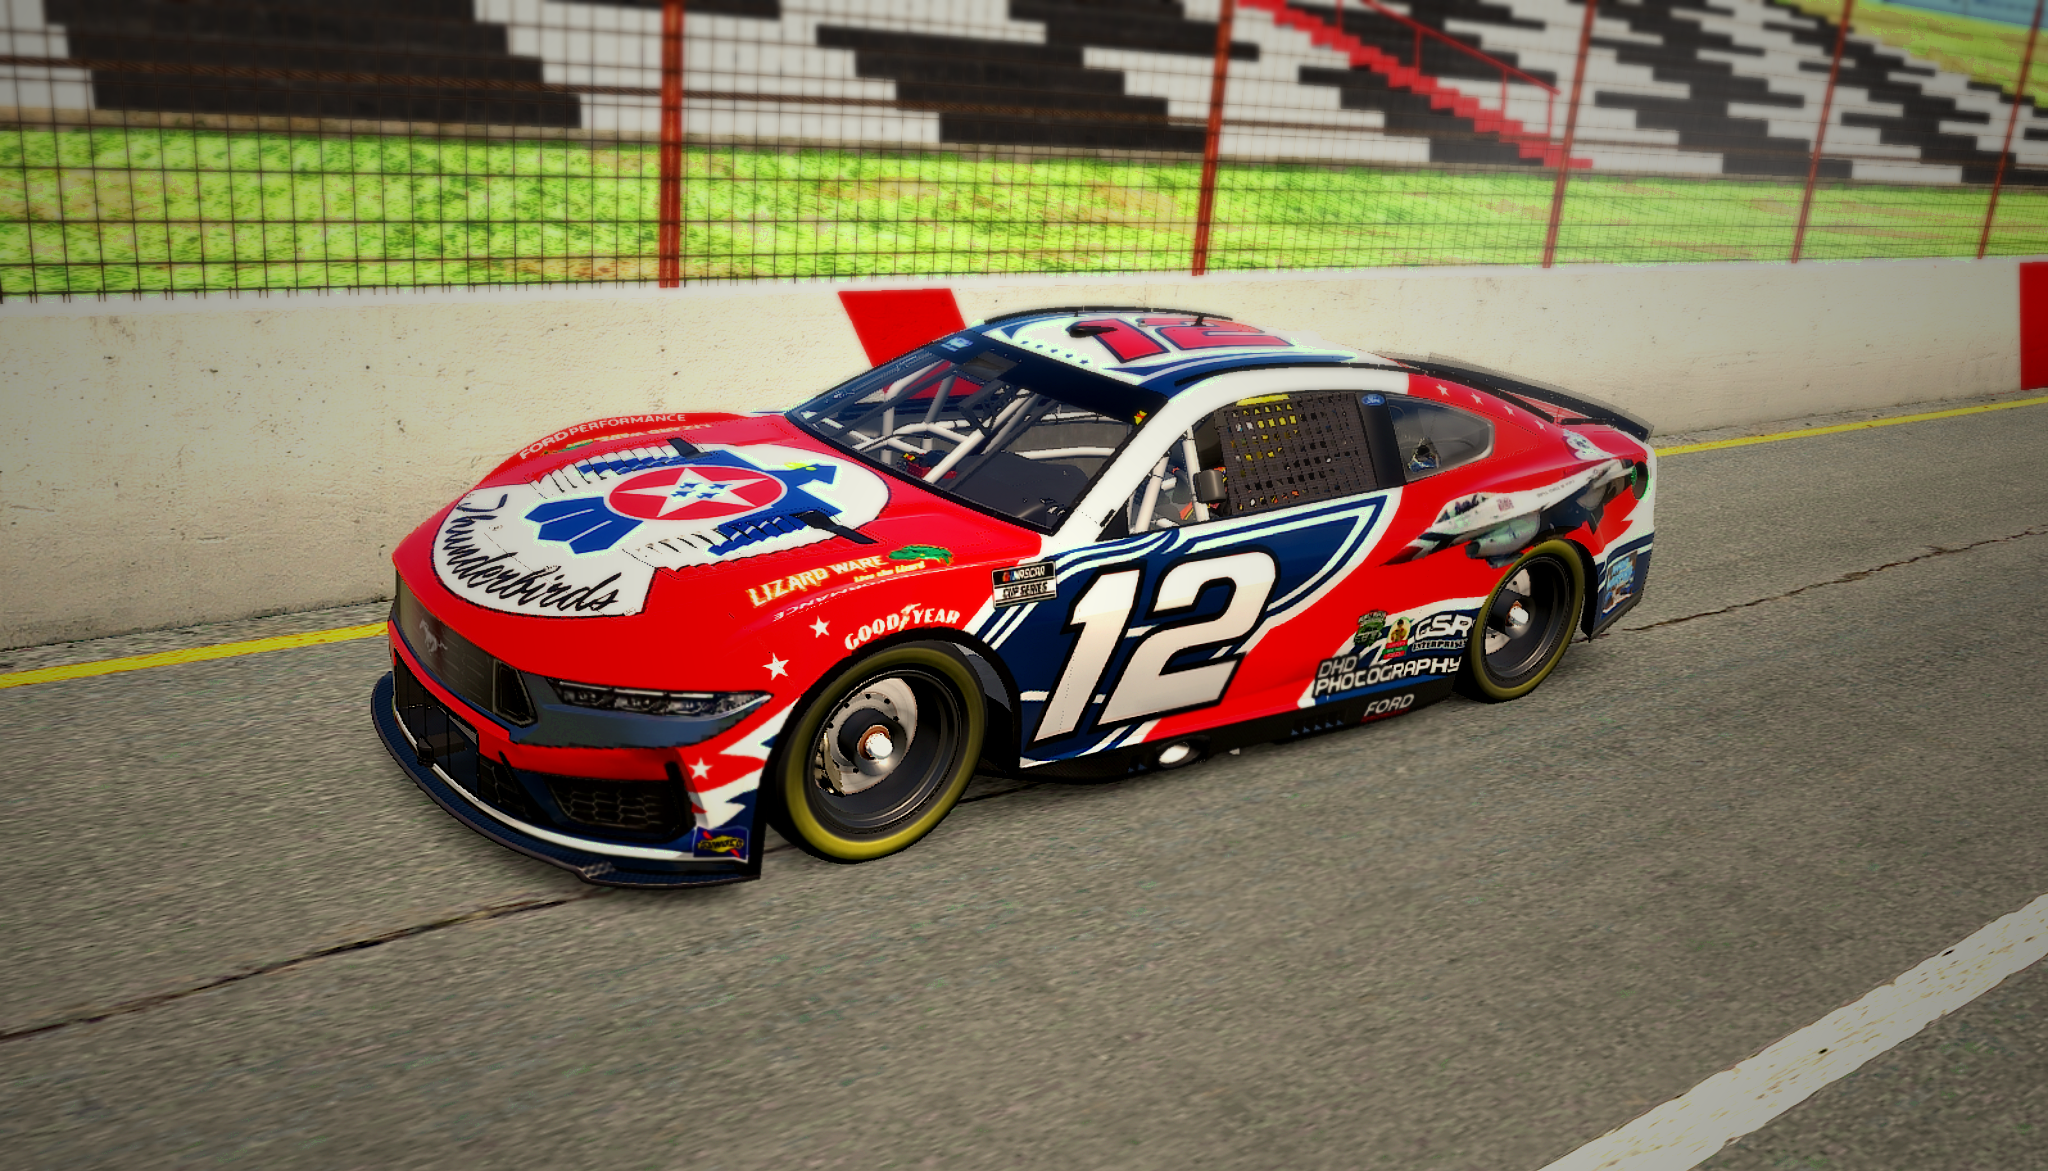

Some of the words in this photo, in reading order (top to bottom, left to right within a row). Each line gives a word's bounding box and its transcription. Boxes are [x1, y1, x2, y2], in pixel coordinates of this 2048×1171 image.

[1066, 317, 1295, 363] 12
[442, 493, 622, 611] Thunderbirds
[745, 566, 830, 608] LIZARD
[826, 555, 889, 575] WARE
[844, 603, 960, 650] GOODYEAR
[1030, 549, 1279, 745] 12
[1415, 614, 1473, 641] GSR
[1317, 655, 1359, 678] DHD
[1363, 693, 1415, 716] FORD
